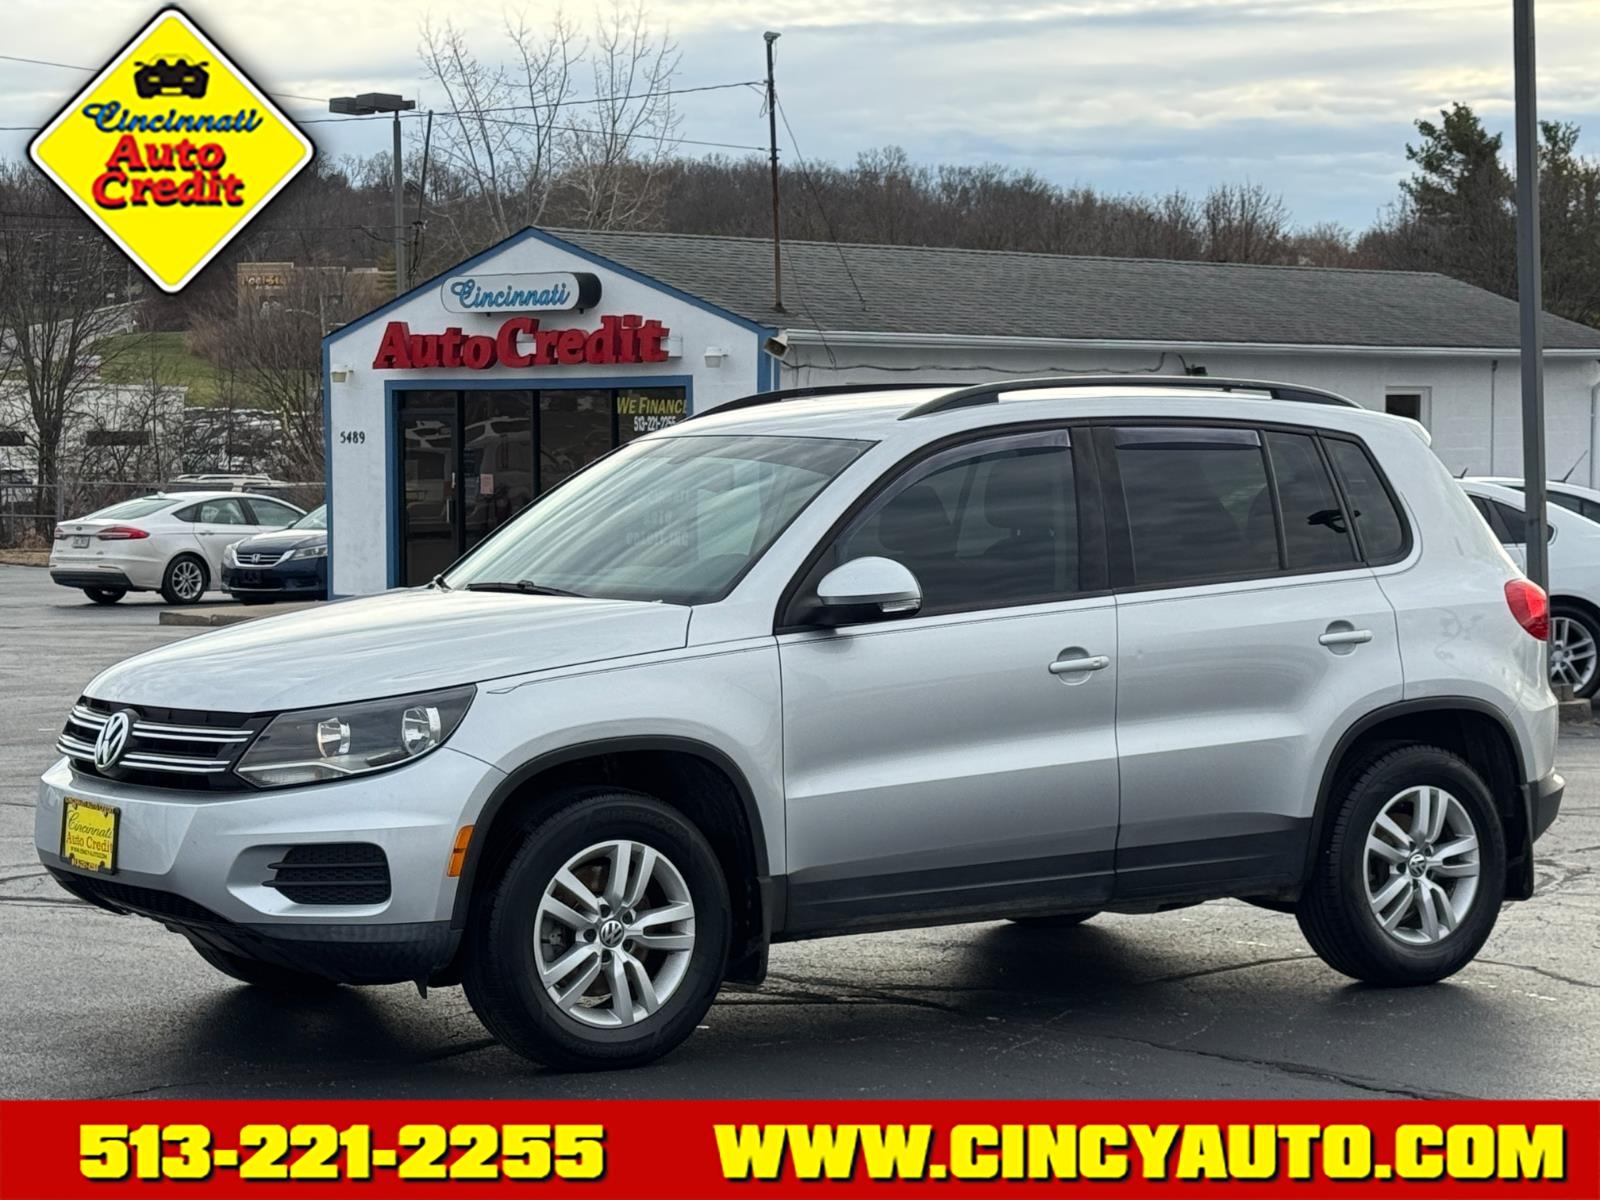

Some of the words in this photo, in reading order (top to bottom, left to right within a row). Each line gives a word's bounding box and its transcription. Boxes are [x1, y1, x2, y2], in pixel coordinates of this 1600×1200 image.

[450, 278, 570, 309] Cincinnati
[617, 397, 637, 414] WE
[340, 430, 366, 444] 5489
[67, 810, 112, 839] Cincinnati
[66, 831, 85, 847] Auto
